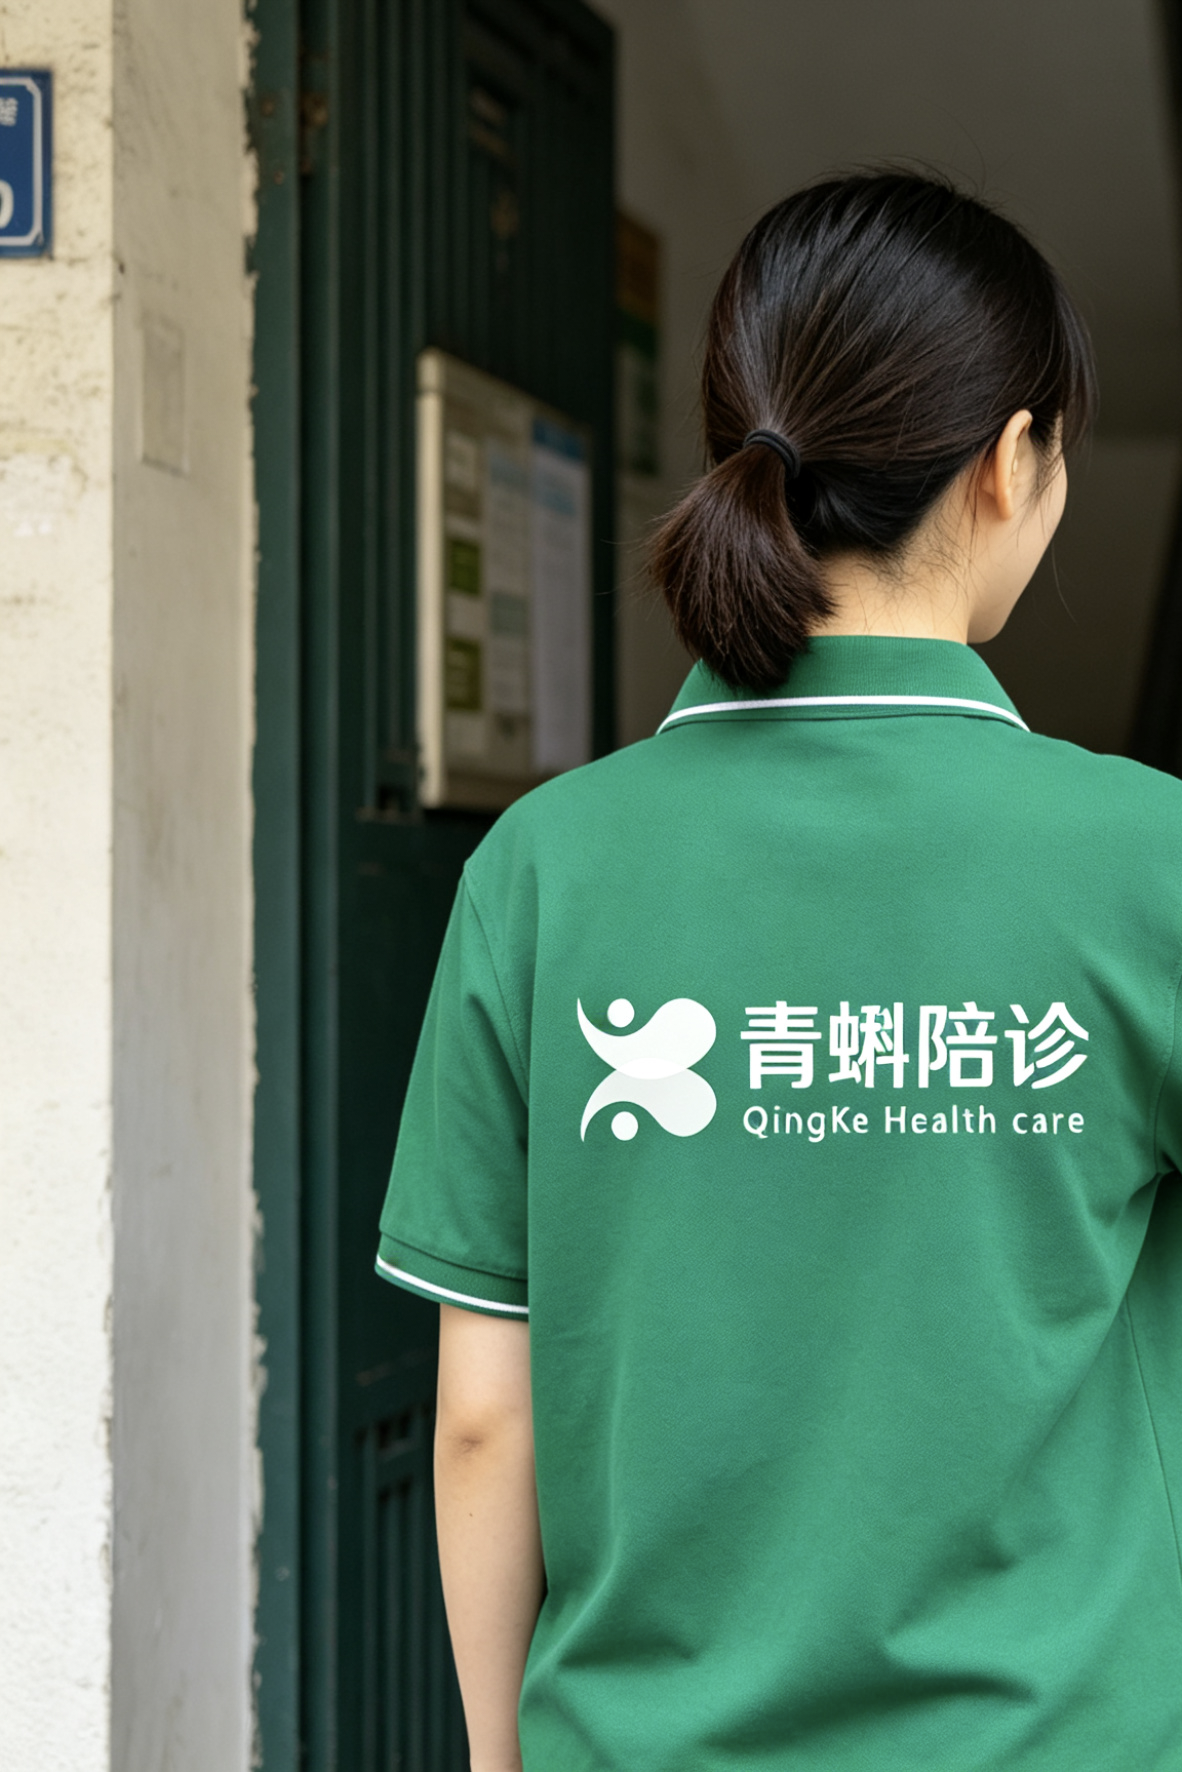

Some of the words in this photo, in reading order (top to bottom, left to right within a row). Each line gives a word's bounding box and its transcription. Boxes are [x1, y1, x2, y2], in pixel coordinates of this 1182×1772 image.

[740, 1000, 1089, 1090] 青蝌陪诊
[743, 1105, 868, 1143] QingKe
[884, 1104, 996, 1134] Health
[1012, 1112, 1085, 1135] care
